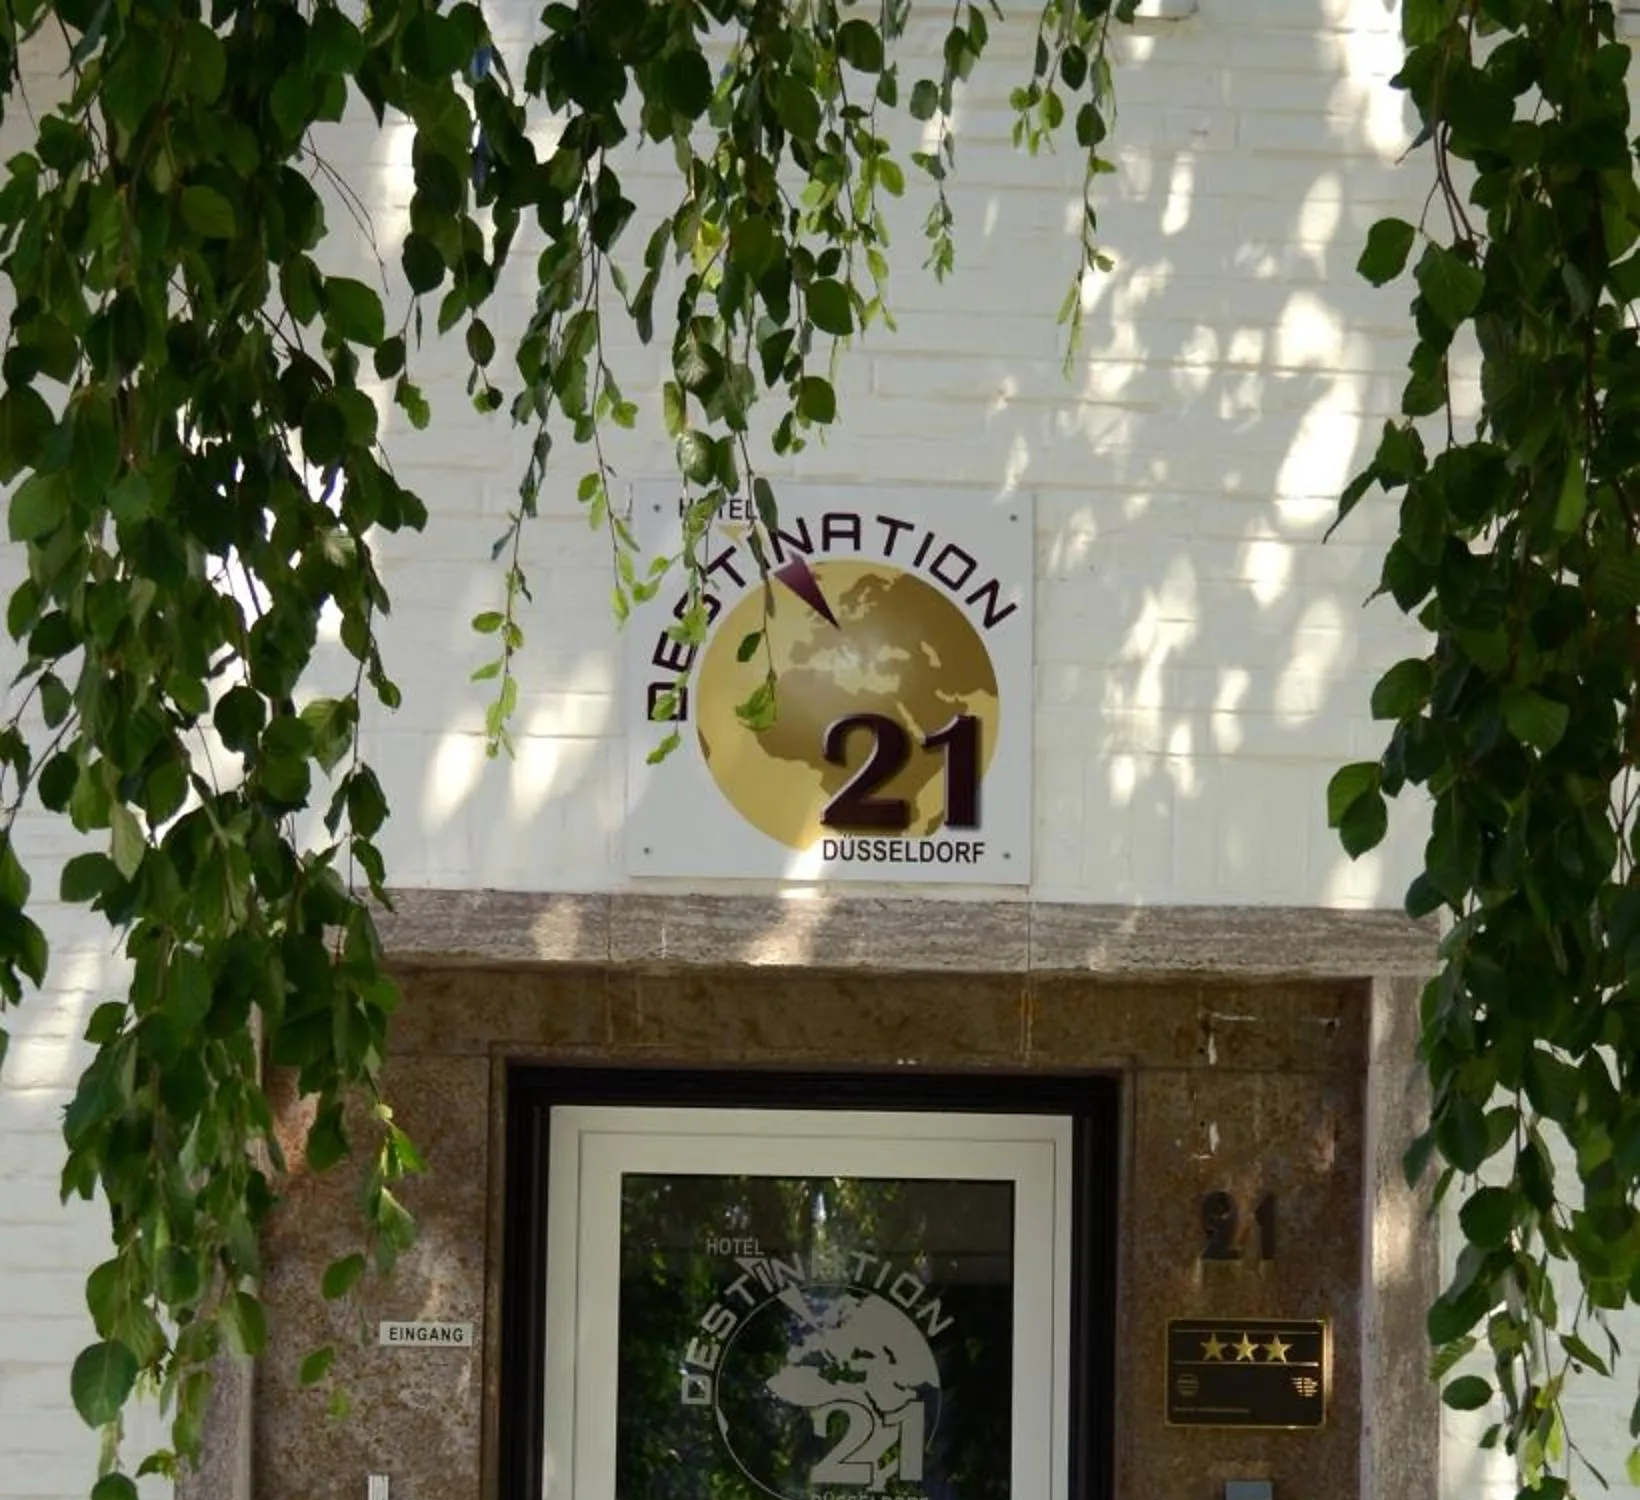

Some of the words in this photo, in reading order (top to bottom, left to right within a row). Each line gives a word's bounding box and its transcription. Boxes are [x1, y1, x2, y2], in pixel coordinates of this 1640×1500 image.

[679, 497, 757, 520] HEL
[647, 512, 1018, 721] DESTNATION
[819, 713, 983, 831] 21
[822, 835, 986, 864] DÜSSELDORF
[706, 1237, 764, 1257] HOTEL
[1202, 1190, 1276, 1260] 21
[389, 1326, 465, 1343] EINGANG
[810, 1400, 926, 1485] 21
